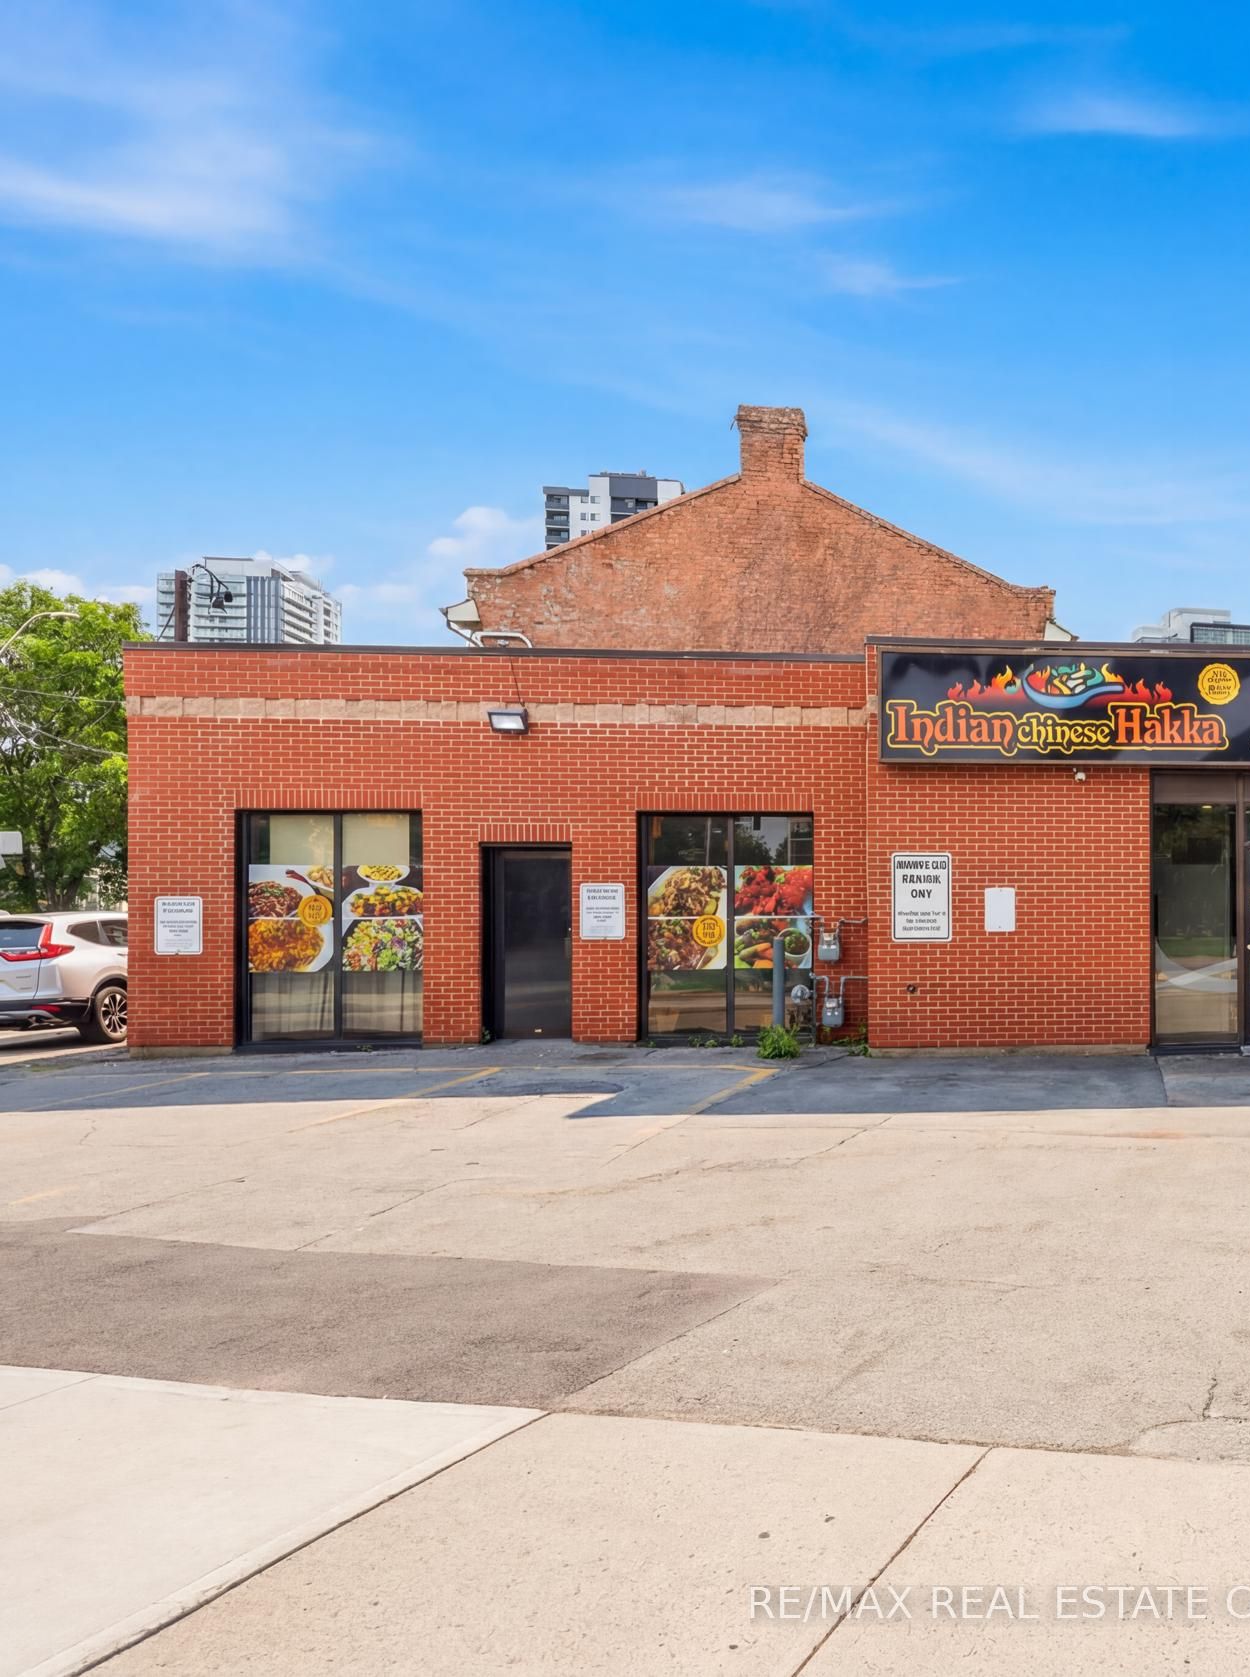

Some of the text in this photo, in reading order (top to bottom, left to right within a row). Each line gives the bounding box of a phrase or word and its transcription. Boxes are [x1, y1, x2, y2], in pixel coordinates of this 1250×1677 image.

[892, 704, 1223, 749] Indian chinese Hakka
